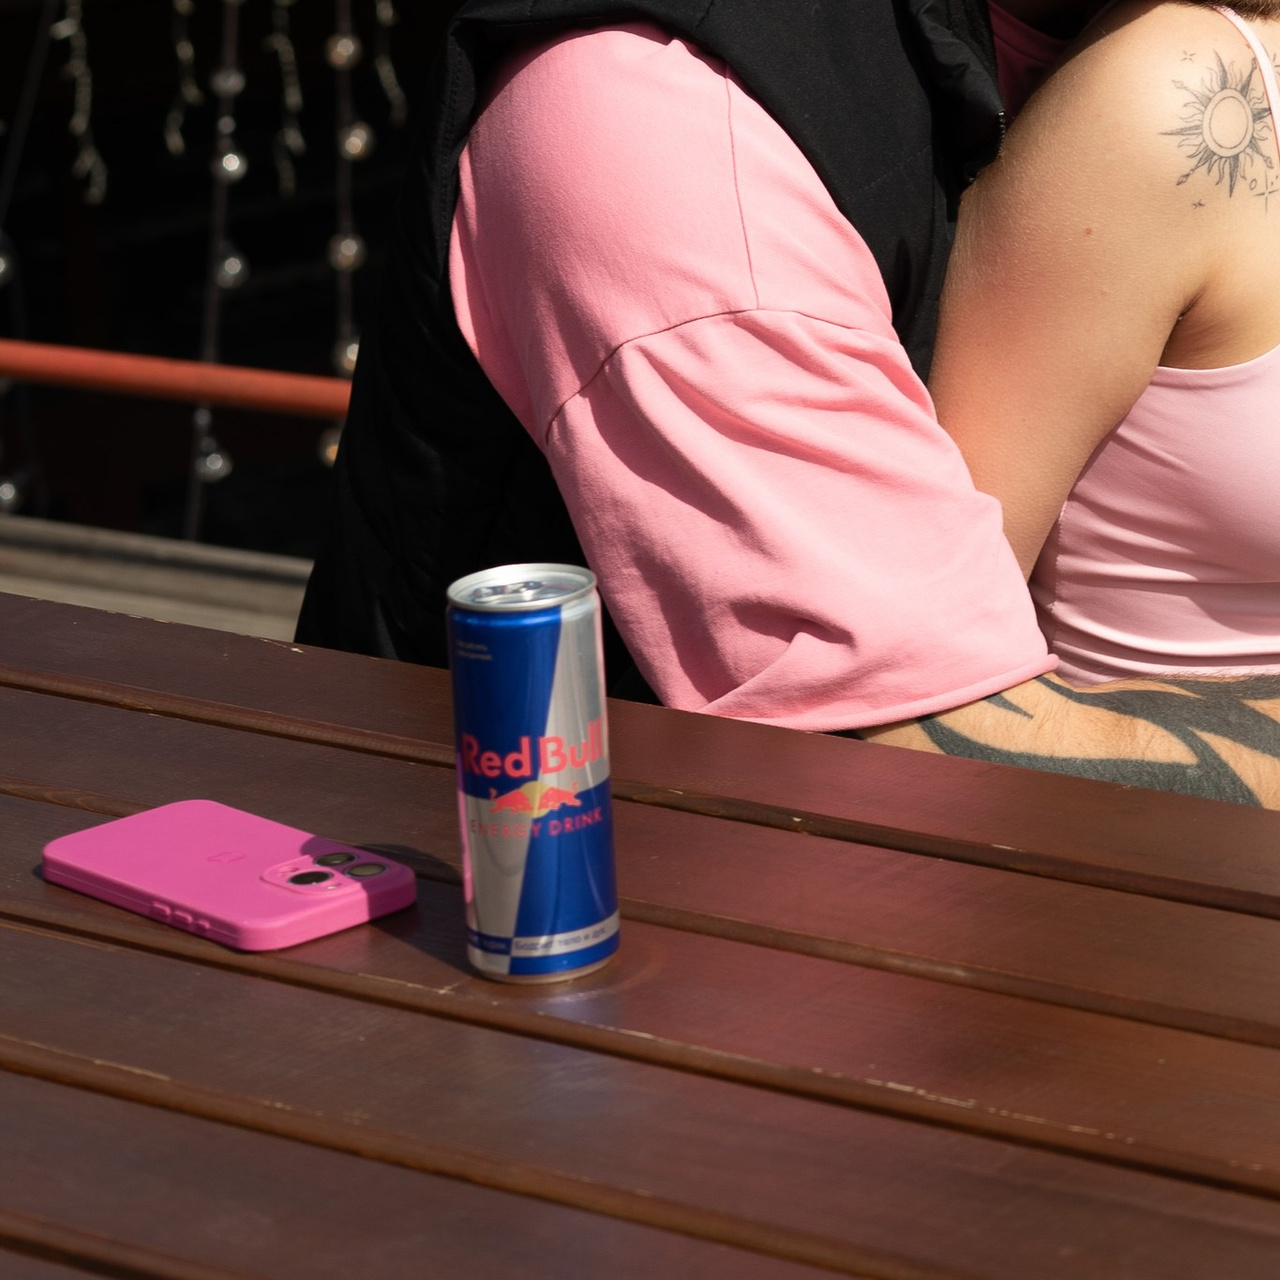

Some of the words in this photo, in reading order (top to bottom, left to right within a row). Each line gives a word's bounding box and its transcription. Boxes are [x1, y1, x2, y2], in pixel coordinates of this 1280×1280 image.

[461, 733, 531, 778] Red
[538, 717, 604, 775] Bull
[470, 818, 541, 838] ENERGY
[549, 807, 602, 837] DRINK
